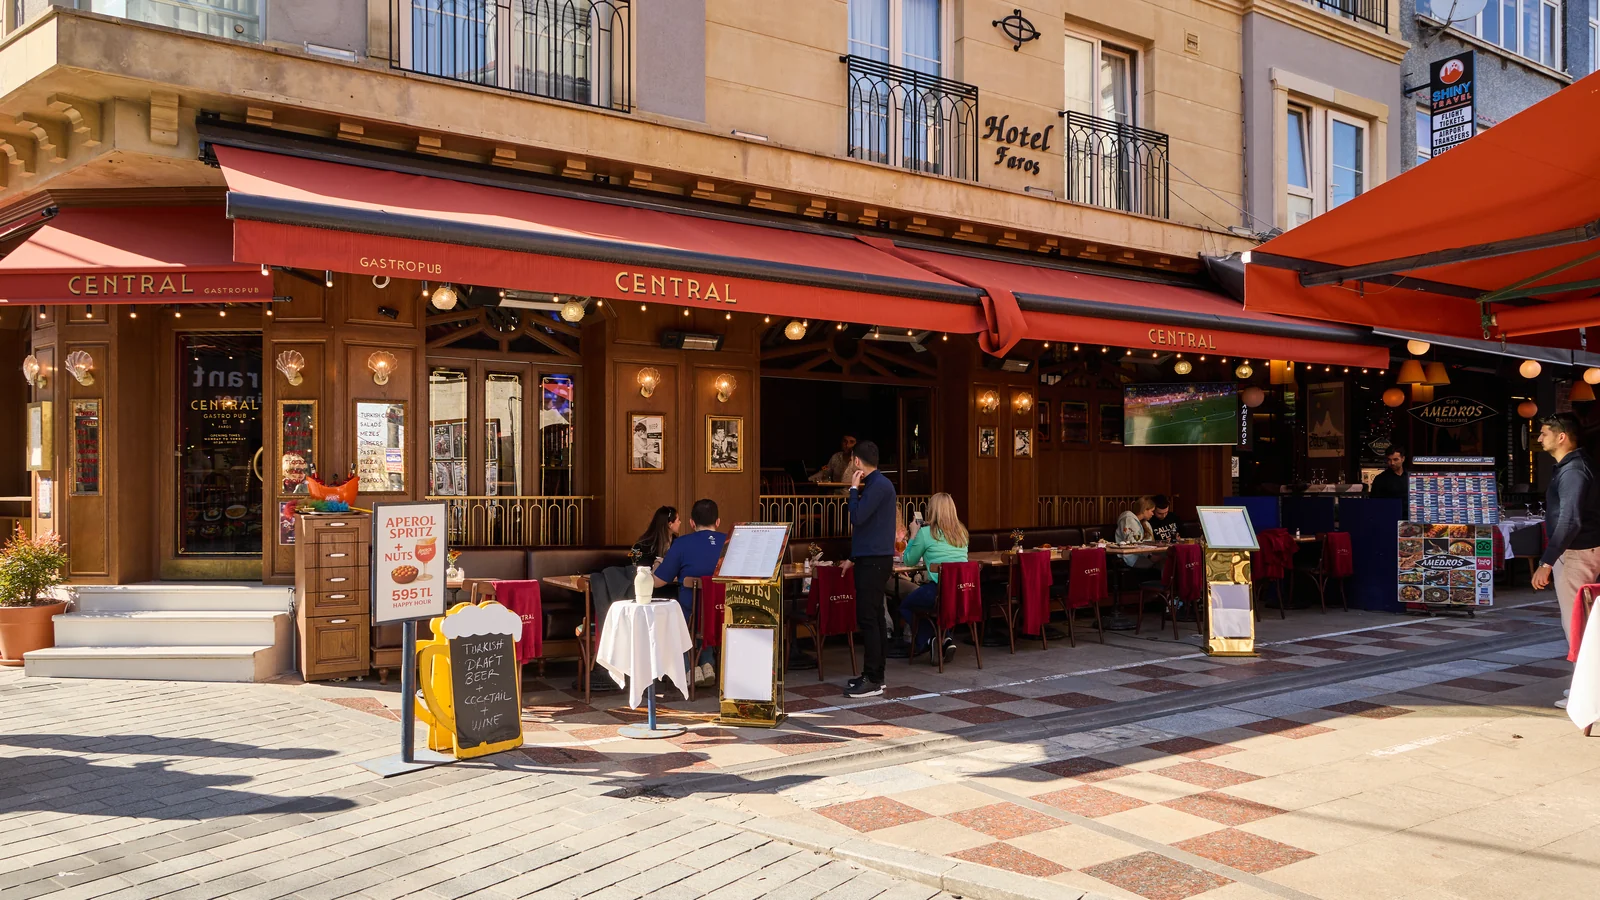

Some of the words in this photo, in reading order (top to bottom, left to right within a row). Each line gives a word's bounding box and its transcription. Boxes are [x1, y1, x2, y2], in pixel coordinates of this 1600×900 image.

[1433, 81, 1472, 101] SHINY
[1433, 93, 1472, 108] TRAVEL
[1439, 116, 1465, 128] TICKETS
[1441, 109, 1464, 121] FLIGHT
[983, 115, 1054, 151] Hotel
[1434, 131, 1470, 146] TRANSFERS
[1439, 125, 1465, 138] AIRPORT
[994, 146, 1040, 175] Faros
[360, 257, 442, 274] GASTROPUB
[68, 274, 194, 295] CENTRAL
[615, 271, 738, 303] CENTRAL
[1148, 328, 1217, 350] CENTRAL
[191, 400, 259, 411] CENTRAL
[1420, 406, 1484, 417] AMEDROS
[1240, 404, 1249, 445] AMEDROS
[386, 516, 436, 528] APEROL
[390, 527, 433, 539] SPRITZ
[385, 552, 413, 562] NUTS
[392, 588, 418, 601] 595
[420, 588, 433, 598] TL
[462, 639, 504, 655] TURKISH
[465, 654, 503, 671] DRAFT
[465, 669, 500, 685] BEER
[472, 714, 503, 731] WINE
